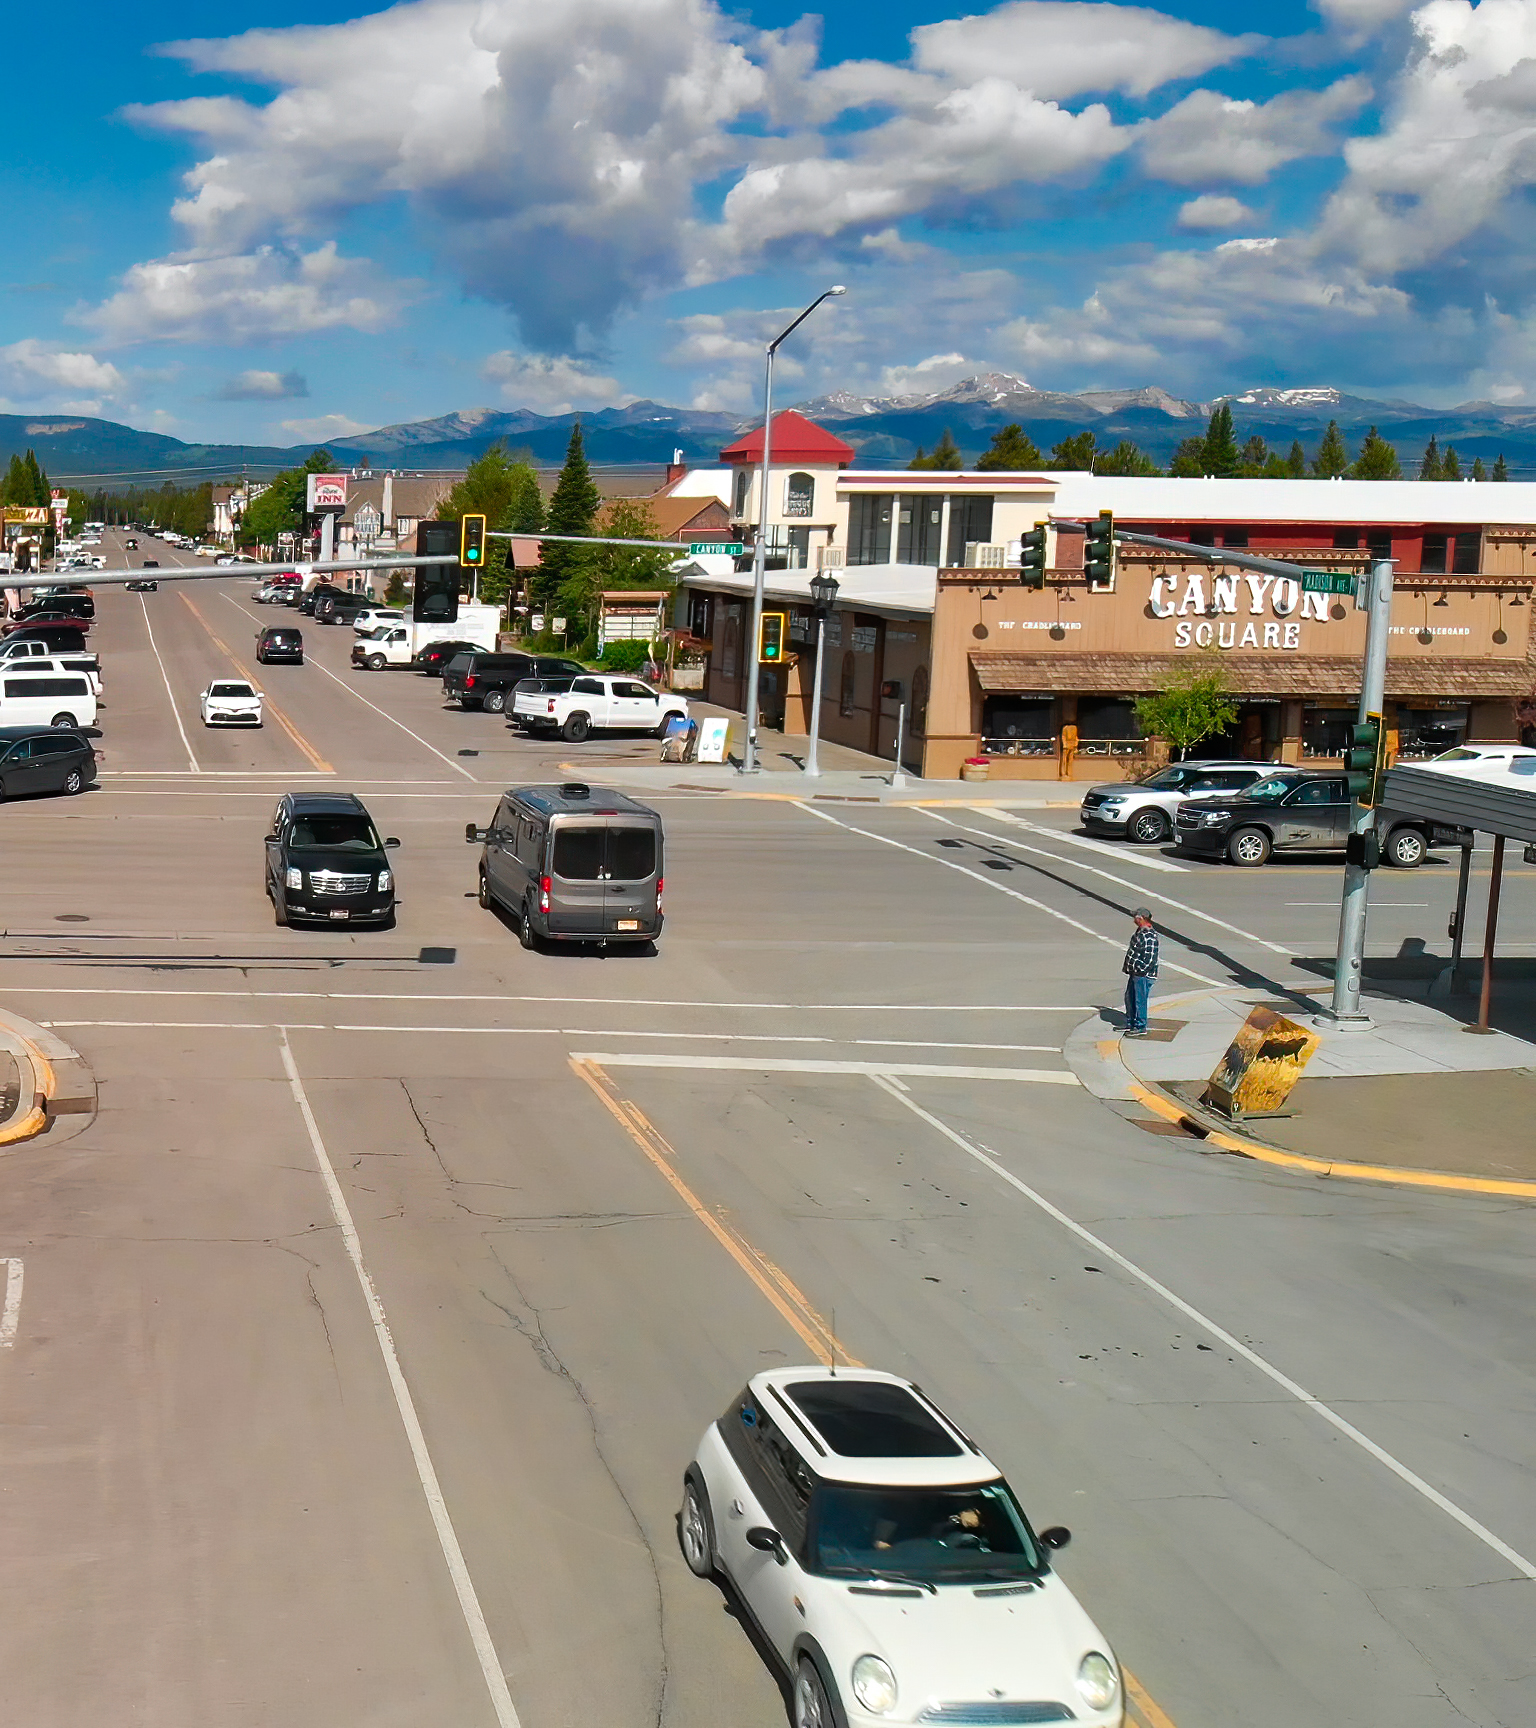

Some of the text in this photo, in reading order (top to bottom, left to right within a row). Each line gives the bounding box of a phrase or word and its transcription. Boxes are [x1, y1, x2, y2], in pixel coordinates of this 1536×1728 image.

[317, 495, 342, 503] INN
[696, 544, 726, 554] CANYON
[1149, 574, 1330, 622] CANYON
[1175, 622, 1300, 649] SQUARE
